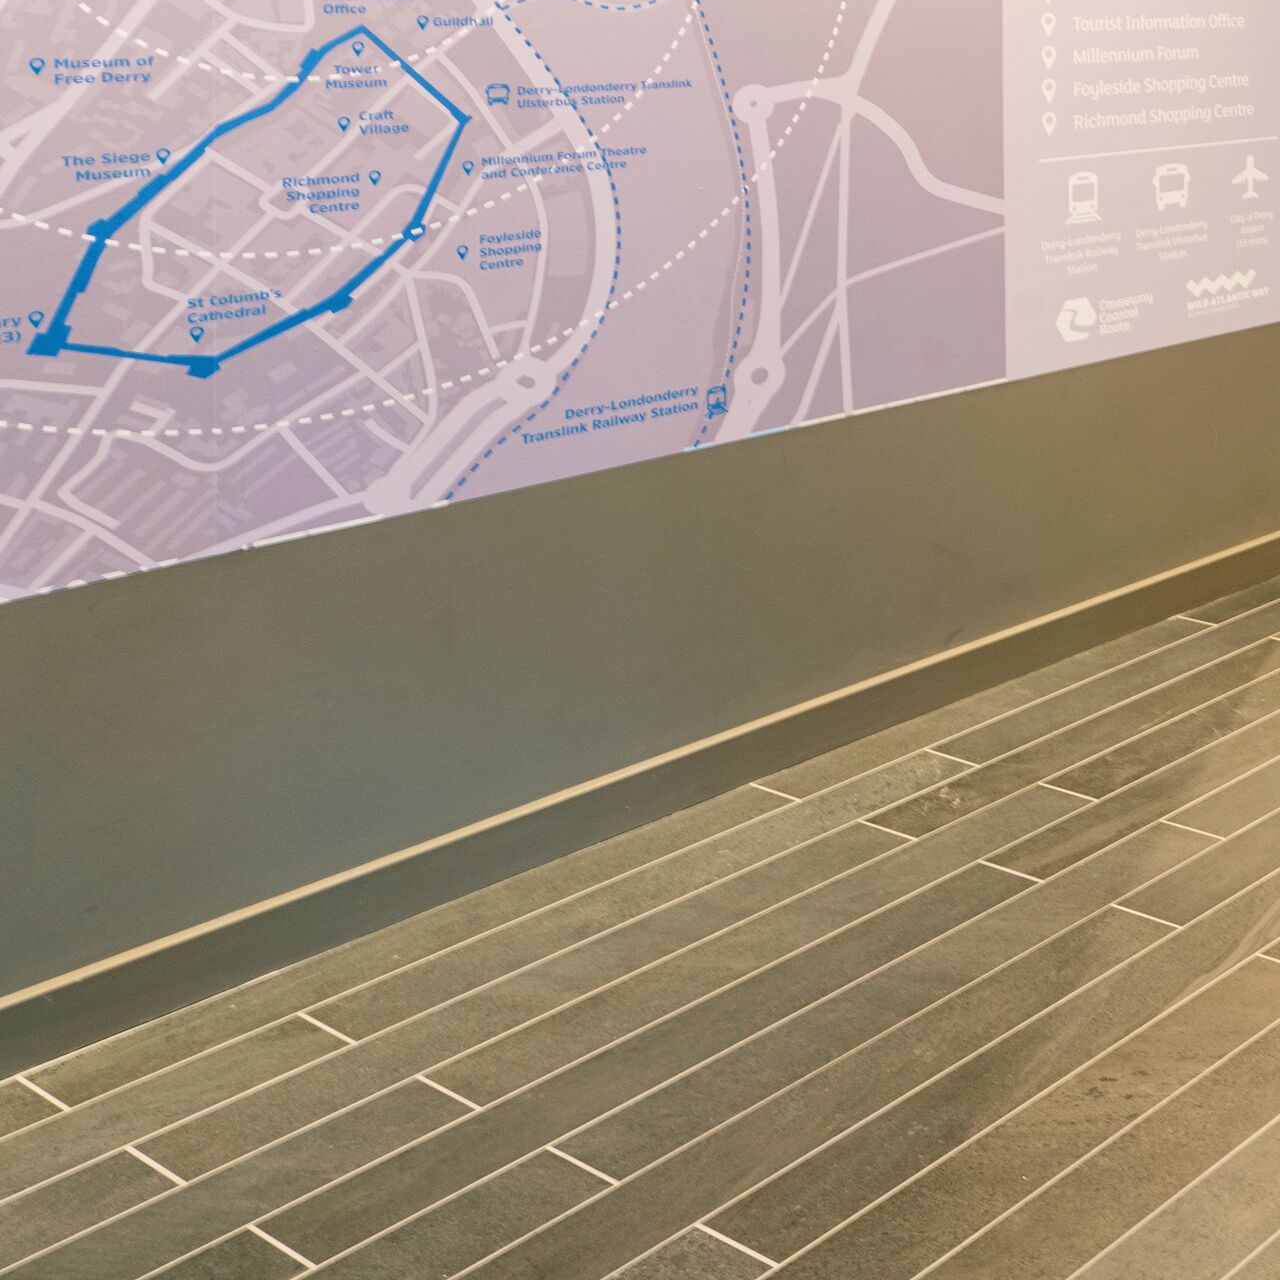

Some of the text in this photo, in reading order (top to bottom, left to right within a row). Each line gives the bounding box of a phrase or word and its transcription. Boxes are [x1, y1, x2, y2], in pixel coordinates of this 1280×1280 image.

[323, 3, 366, 14] Office
[433, 17, 494, 27] Guildhall
[1073, 13, 1246, 32] Tourist Information Office
[54, 56, 154, 69] Museum of
[1073, 47, 1199, 64] Millennium Forum
[334, 64, 379, 75] Tower
[54, 72, 151, 85] Free Derry
[325, 79, 388, 89] Museum
[517, 80, 692, 95] Derry-Londonderry Translink
[1073, 73, 1249, 99] Foyleside Shopping Centre
[517, 95, 625, 108] Ulsterbus Station
[359, 109, 394, 120] Craft
[1073, 103, 1255, 129] Richmond Shopping Centre
[359, 123, 409, 135] Village
[62, 153, 150, 166] The Siege
[481, 146, 647, 166] Millennium Forum Theatre
[76, 168, 151, 181] Museum
[481, 160, 627, 180] and Conference Centre
[282, 173, 359, 187] Richmond
[287, 189, 359, 201] Shopping
[309, 203, 360, 213] Centre
[480, 229, 541, 244] Foyleside
[480, 243, 542, 257] Shopping
[480, 258, 523, 270] Centre
[1067, 263, 1098, 274] Station
[187, 288, 281, 309] St Columb's
[1099, 293, 1154, 310] Causeway
[1210, 292, 1250, 306] ATLANTIC
[187, 305, 266, 324] Cathedral
[1099, 308, 1138, 323] Coastal
[1100, 322, 1130, 336] Route
[565, 386, 698, 419] Derry-Londonderry
[521, 402, 698, 444] Translink Railway Station
